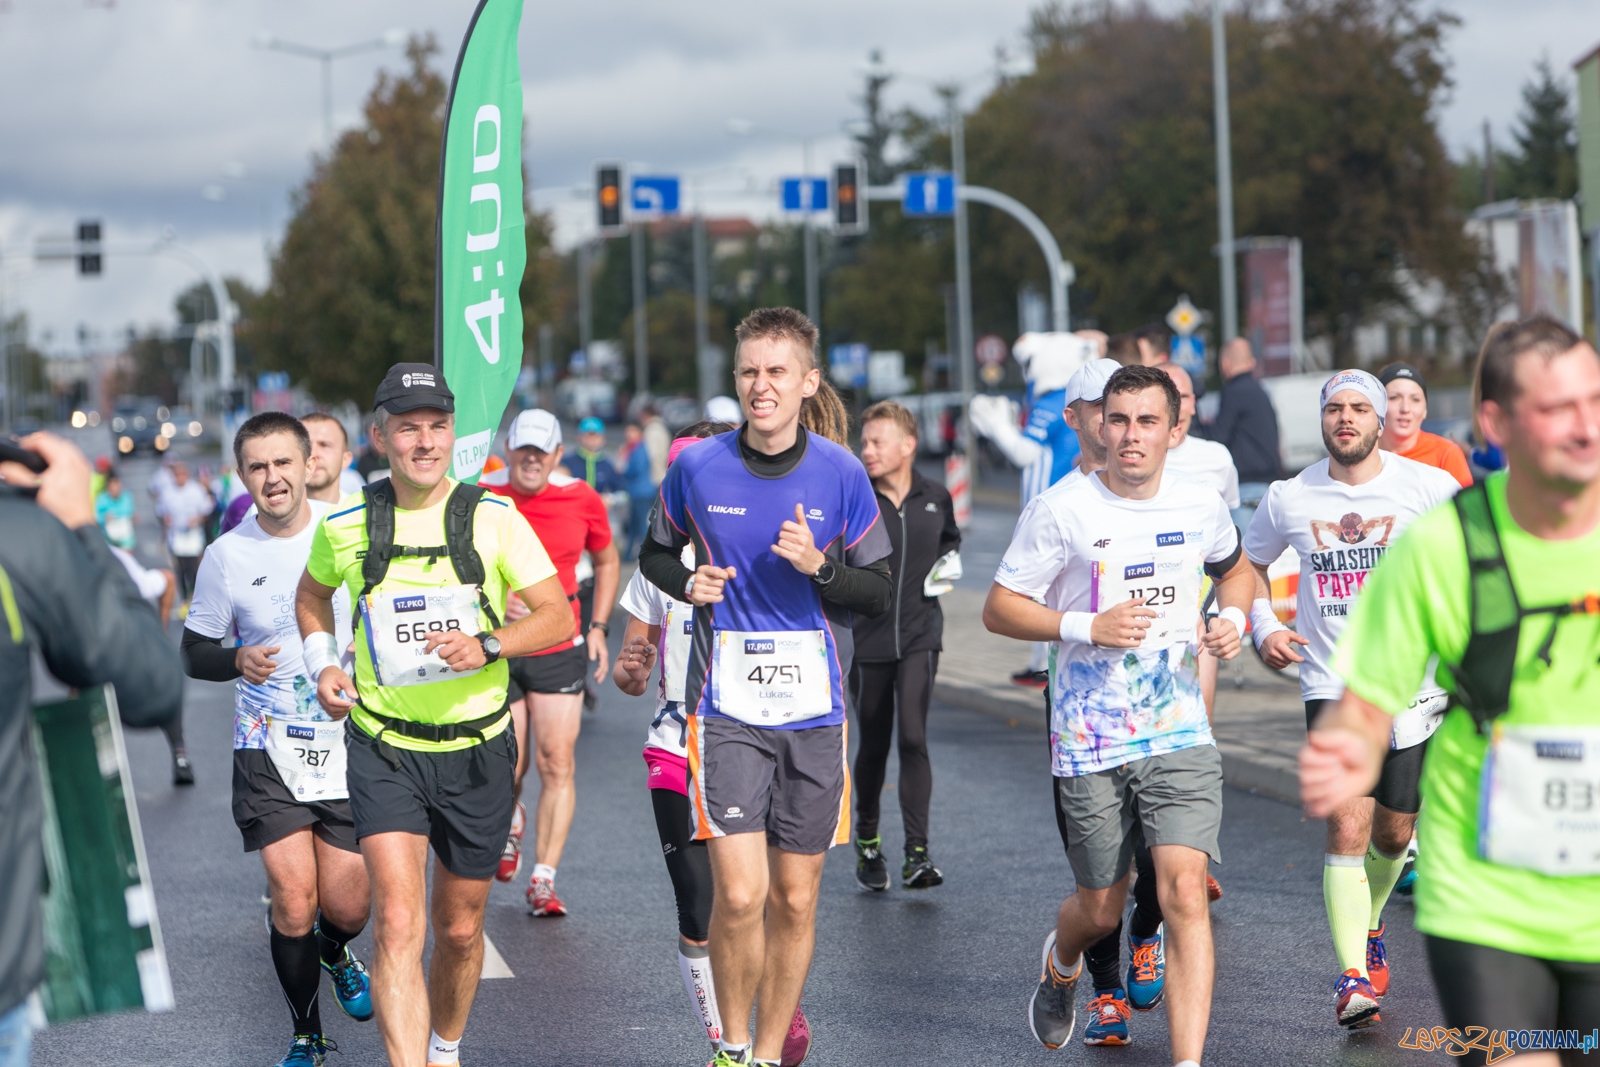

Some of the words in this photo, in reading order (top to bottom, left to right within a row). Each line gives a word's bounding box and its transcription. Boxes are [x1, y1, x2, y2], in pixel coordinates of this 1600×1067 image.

[1158, 534, 1183, 544] 17.PKO
[1311, 546, 1392, 572] SMASHIN
[1127, 565, 1153, 576] 17.PKO
[396, 599, 424, 610] 17.PKO
[1320, 603, 1348, 618] KREW
[746, 642, 773, 651] 17.PKO
[747, 664, 802, 685] 4751
[289, 728, 313, 738] 17.PKO
